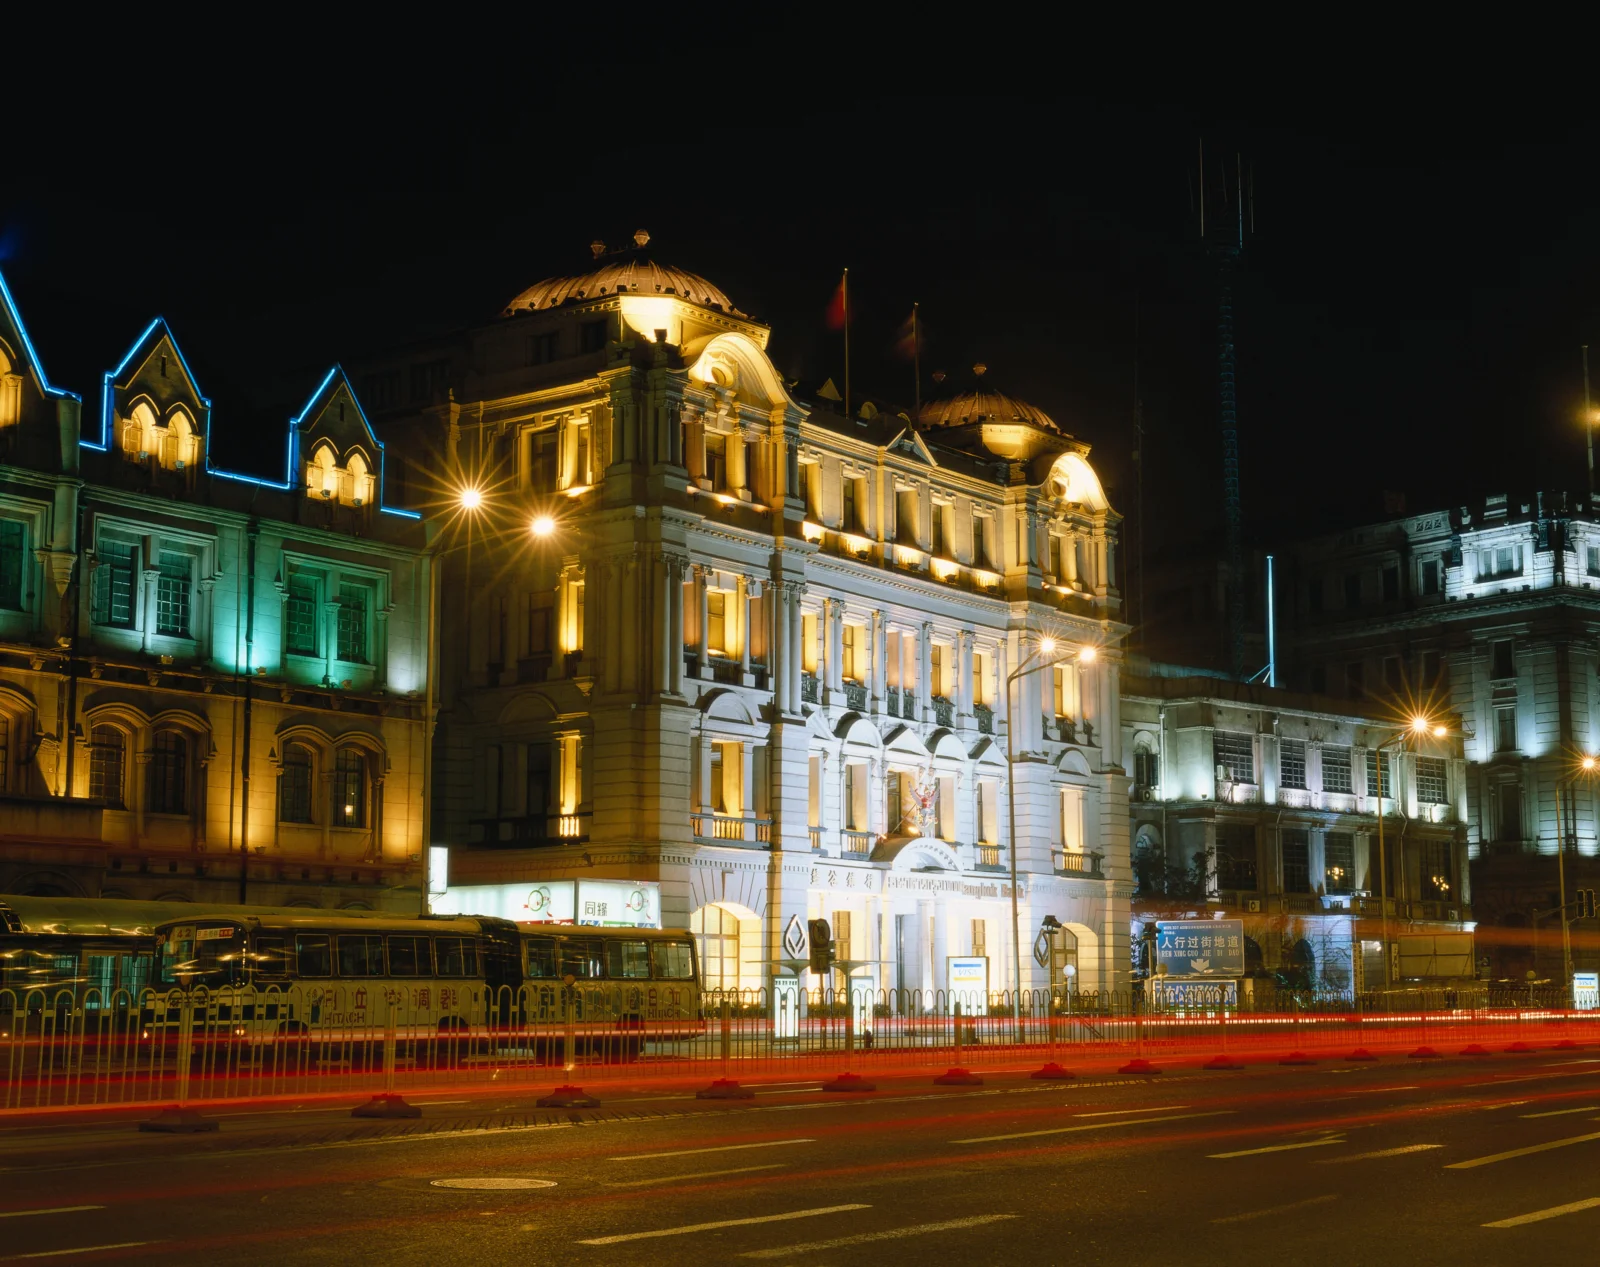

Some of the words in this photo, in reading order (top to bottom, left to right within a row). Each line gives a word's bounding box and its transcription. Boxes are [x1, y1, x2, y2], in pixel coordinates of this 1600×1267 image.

[1001, 883, 1025, 898] Bak
[1161, 935, 1239, 948] 人行过街地道
[1202, 949, 1211, 957] JIE
